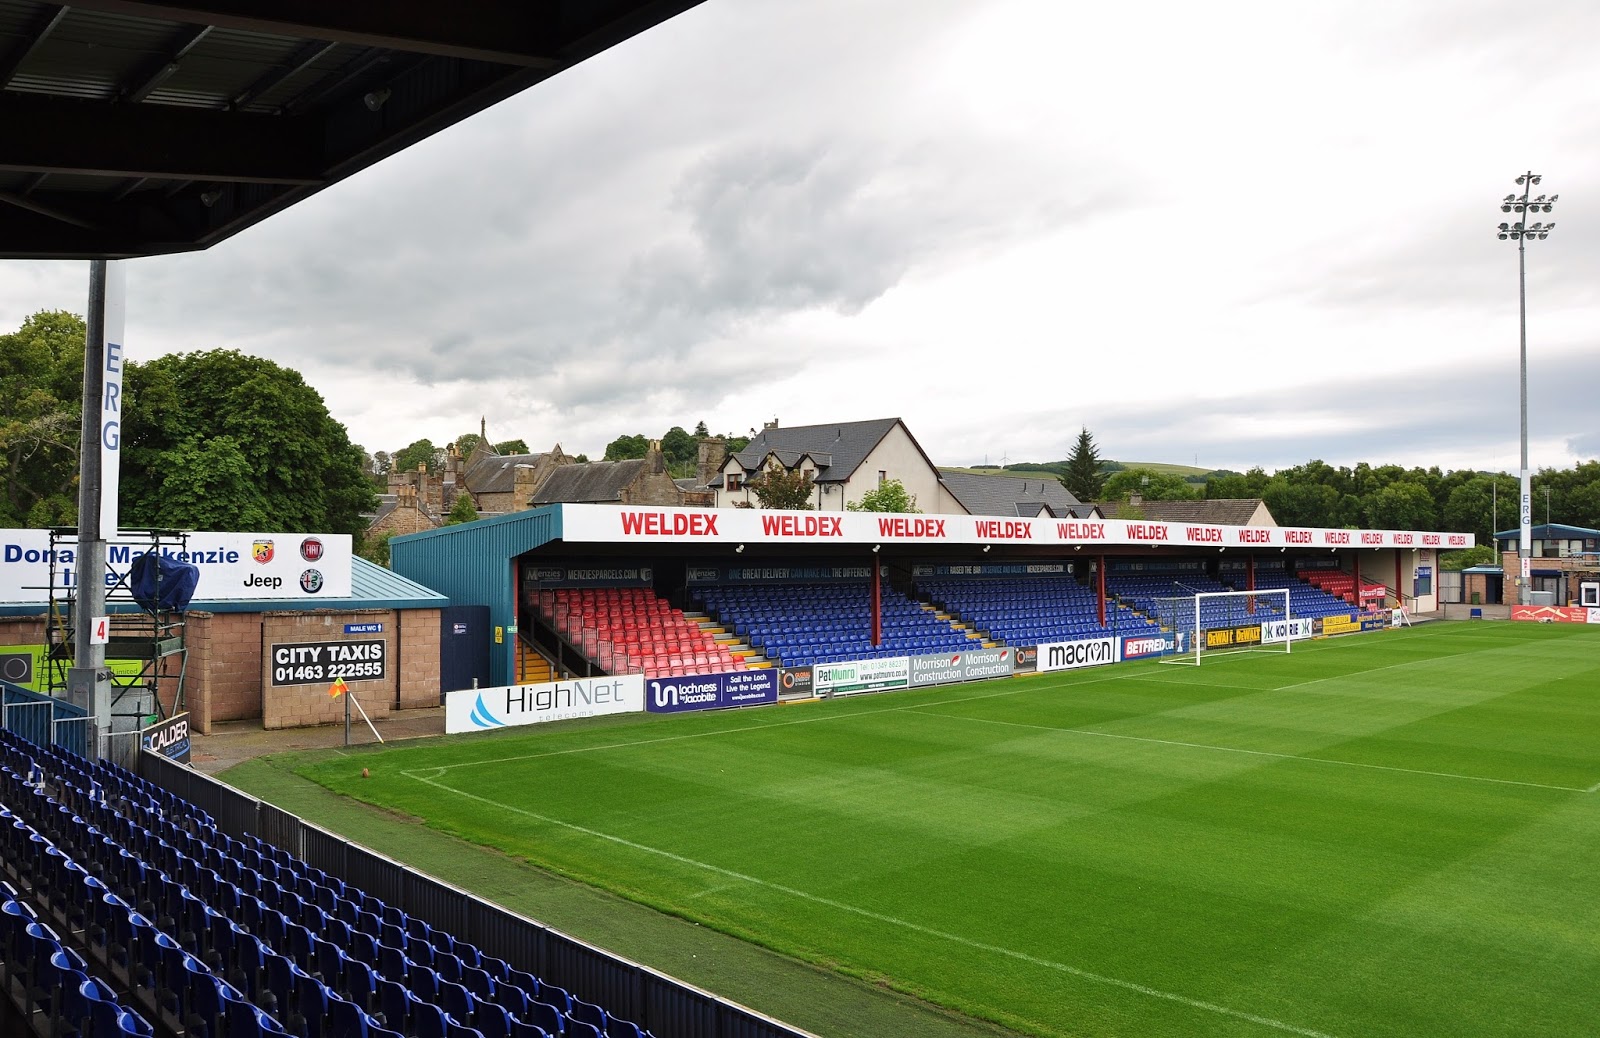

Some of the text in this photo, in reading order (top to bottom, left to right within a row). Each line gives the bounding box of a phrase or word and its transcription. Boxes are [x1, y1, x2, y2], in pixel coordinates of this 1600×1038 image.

[102, 343, 121, 451] ERG
[1522, 494, 1530, 525] ERG
[621, 512, 718, 535] WELDEX
[762, 516, 842, 536] WELDEX
[878, 518, 945, 537] WELDEX
[976, 521, 1032, 539] WELDEX
[1057, 523, 1105, 539] WELDEX
[1127, 525, 1168, 541] WELDEX
[1186, 527, 1223, 542] WELDEX
[1239, 530, 1270, 543] WELDEX
[1285, 531, 1312, 544] WELDEX
[1325, 532, 1350, 544] WELDEX
[1362, 533, 1383, 545] WELDEX
[1393, 534, 1413, 545] WELDEX
[1422, 535, 1440, 546] WELDEX
[1448, 536, 1466, 546] WELDEX
[4, 545, 78, 563] Dona
[306, 544, 319, 556] FIAT
[243, 573, 282, 589] Jeep
[567, 569, 638, 580] MENZIESPARCELS.COM
[742, 568, 761, 579] GREAT
[762, 568, 790, 579] DELIVERY
[831, 568, 842, 578] THE
[842, 568, 872, 578] DIFFERENC
[97, 621, 105, 640] 4
[1049, 641, 1111, 667] macron
[1126, 638, 1166, 655] BETFRED
[276, 644, 382, 665] CITY TAXIS
[965, 652, 999, 665] Morrison
[913, 657, 951, 670] Morrison
[965, 663, 1009, 677] Construction
[276, 662, 382, 681] 01463 222555
[730, 676, 741, 684] Sail
[753, 673, 767, 682] Loch
[818, 668, 855, 682] PatMunro
[859, 669, 908, 681] www.patmunro.co.uk
[913, 668, 962, 683] Construction
[726, 685, 738, 693] Live
[750, 681, 771, 691] Legend
[506, 680, 624, 714] HighNet
